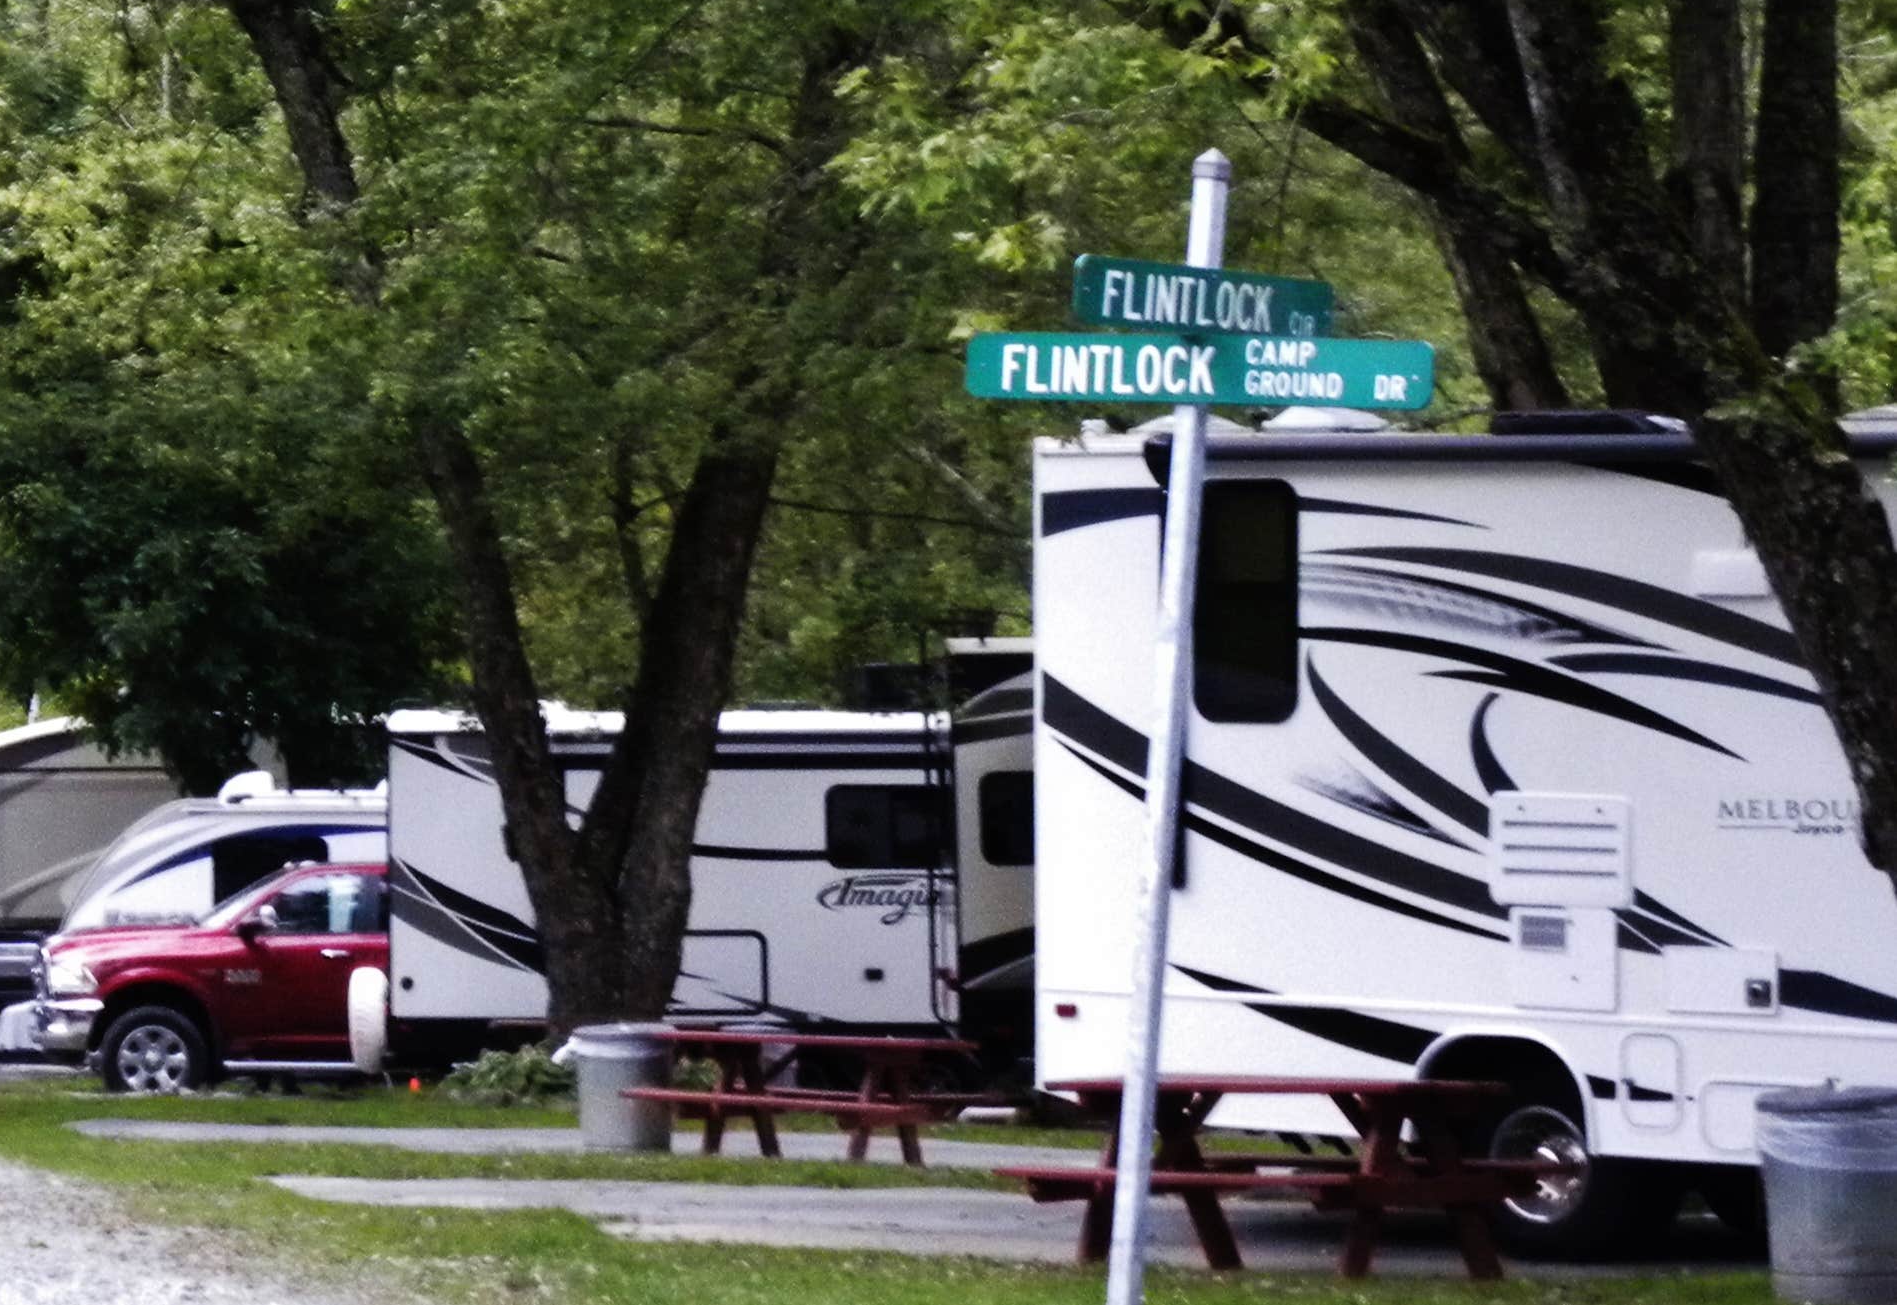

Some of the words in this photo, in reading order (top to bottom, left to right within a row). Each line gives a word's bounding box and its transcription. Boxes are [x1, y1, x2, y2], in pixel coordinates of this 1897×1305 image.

[1102, 269, 1273, 333] FLINTLOCK
[1245, 339, 1316, 368] CAMP
[1001, 343, 1216, 396] FLINTLOCK
[1244, 370, 1344, 400] GROUND
[1373, 374, 1408, 401] DR
[1718, 799, 1854, 820] MELBOU
